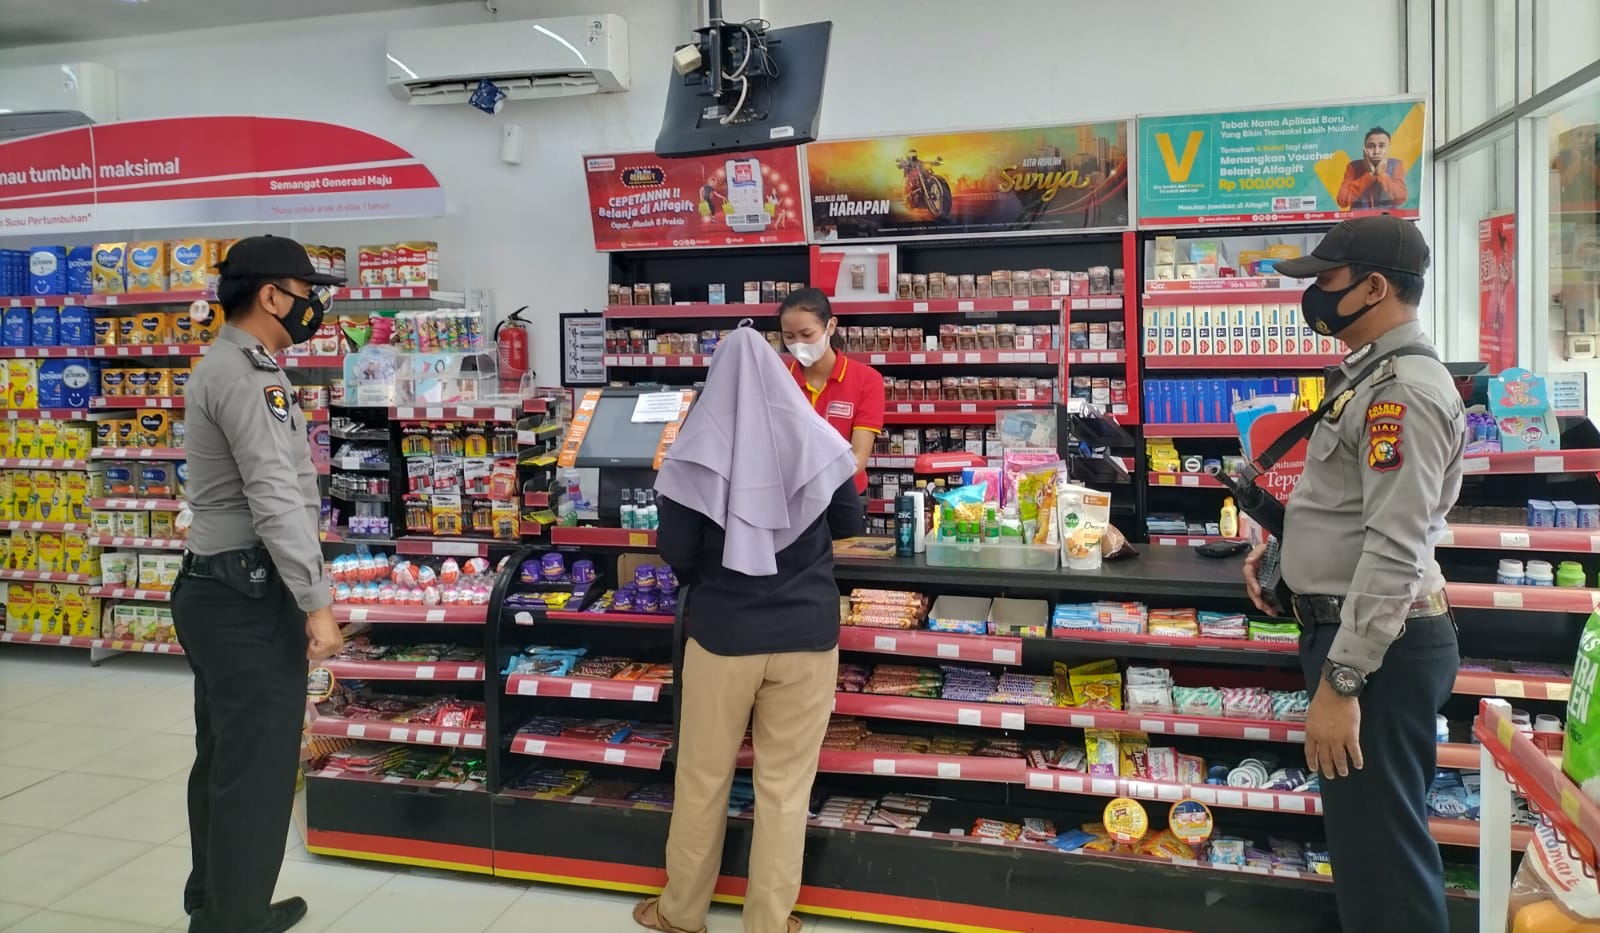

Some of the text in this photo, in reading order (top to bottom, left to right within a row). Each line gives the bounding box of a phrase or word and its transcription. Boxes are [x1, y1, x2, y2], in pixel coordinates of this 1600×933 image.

[1221, 115, 1344, 130] Tebak Nama Aplikasi Baru
[1221, 124, 1359, 140] Yang Bikin Transaksi Lebih Mudah!
[1155, 130, 1204, 183] V
[1220, 145, 1256, 155] Temukan
[1285, 143, 1301, 152] lagi
[1302, 143, 1319, 151] dan
[1220, 152, 1335, 166] Menangkan Voucher
[29, 163, 92, 183] tumbuh
[99, 157, 180, 178] maksimal
[1220, 163, 1305, 177] Belanja Alfagift
[270, 174, 393, 192] Semangat Generasi Maju
[998, 164, 1092, 203] Surya
[1217, 178, 1237, 192] Rp
[608, 188, 671, 208] CEPETANNN
[814, 193, 849, 203] SELALU ADA
[598, 199, 695, 220] Belanja di Alfagift
[829, 199, 890, 217] HARAPAN
[5, 216, 26, 227] Susu
[1371, 424, 1398, 433] RIAU
[1264, 471, 1300, 492] Tepa
